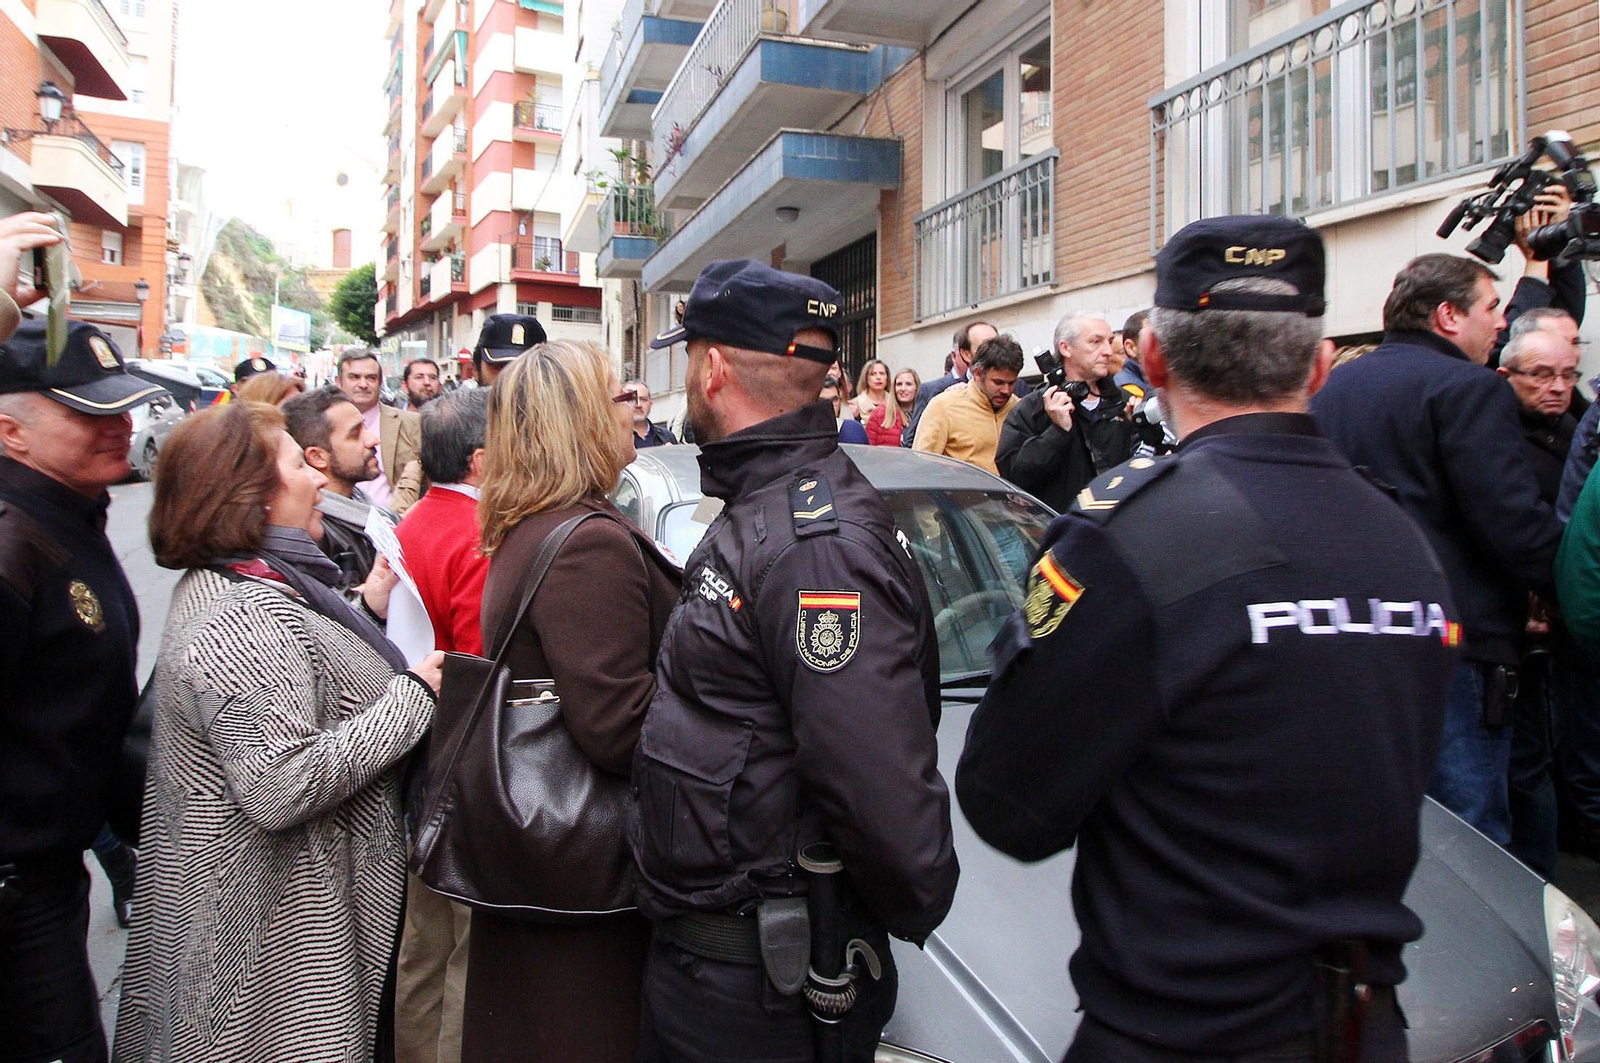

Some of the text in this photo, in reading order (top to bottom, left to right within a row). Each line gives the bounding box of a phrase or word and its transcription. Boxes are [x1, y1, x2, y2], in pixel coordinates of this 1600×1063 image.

[1224, 246, 1286, 266] CNP
[807, 299, 837, 317] CNP
[699, 582, 718, 601] CNP
[700, 566, 734, 602] POLICIA
[1247, 597, 1449, 644] POLICIA
[799, 610, 858, 668] CUERPO NACIONAL DE POLICIA
